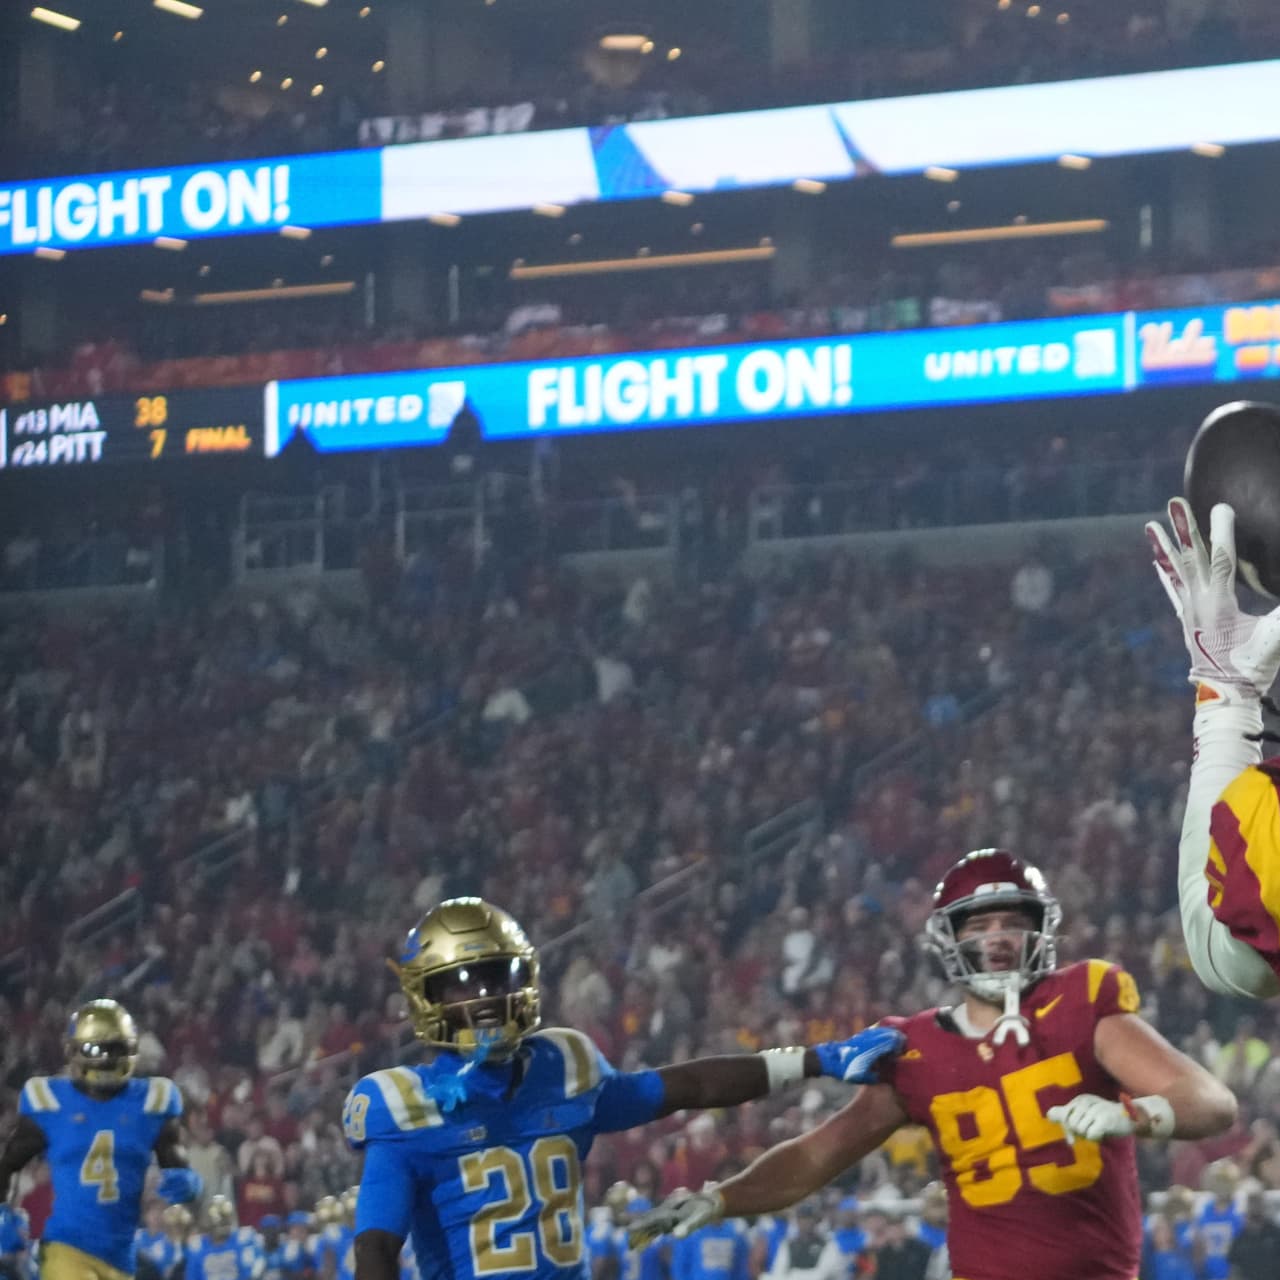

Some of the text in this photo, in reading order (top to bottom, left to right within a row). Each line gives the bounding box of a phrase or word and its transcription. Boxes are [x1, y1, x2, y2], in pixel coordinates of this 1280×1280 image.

[180, 164, 291, 231] ON!
[528, 344, 853, 428] FLIGHT ON!
[924, 343, 1070, 381] UNITED
[50, 401, 100, 432] MIA
[135, 396, 167, 427] 38
[288, 394, 423, 428] UNITED
[50, 431, 107, 465] PITT
[150, 429, 167, 460] 7
[186, 425, 251, 454] FINAL
[930, 1052, 1103, 1210] 85
[81, 1130, 120, 1203] 4
[458, 1134, 584, 1277] 28
